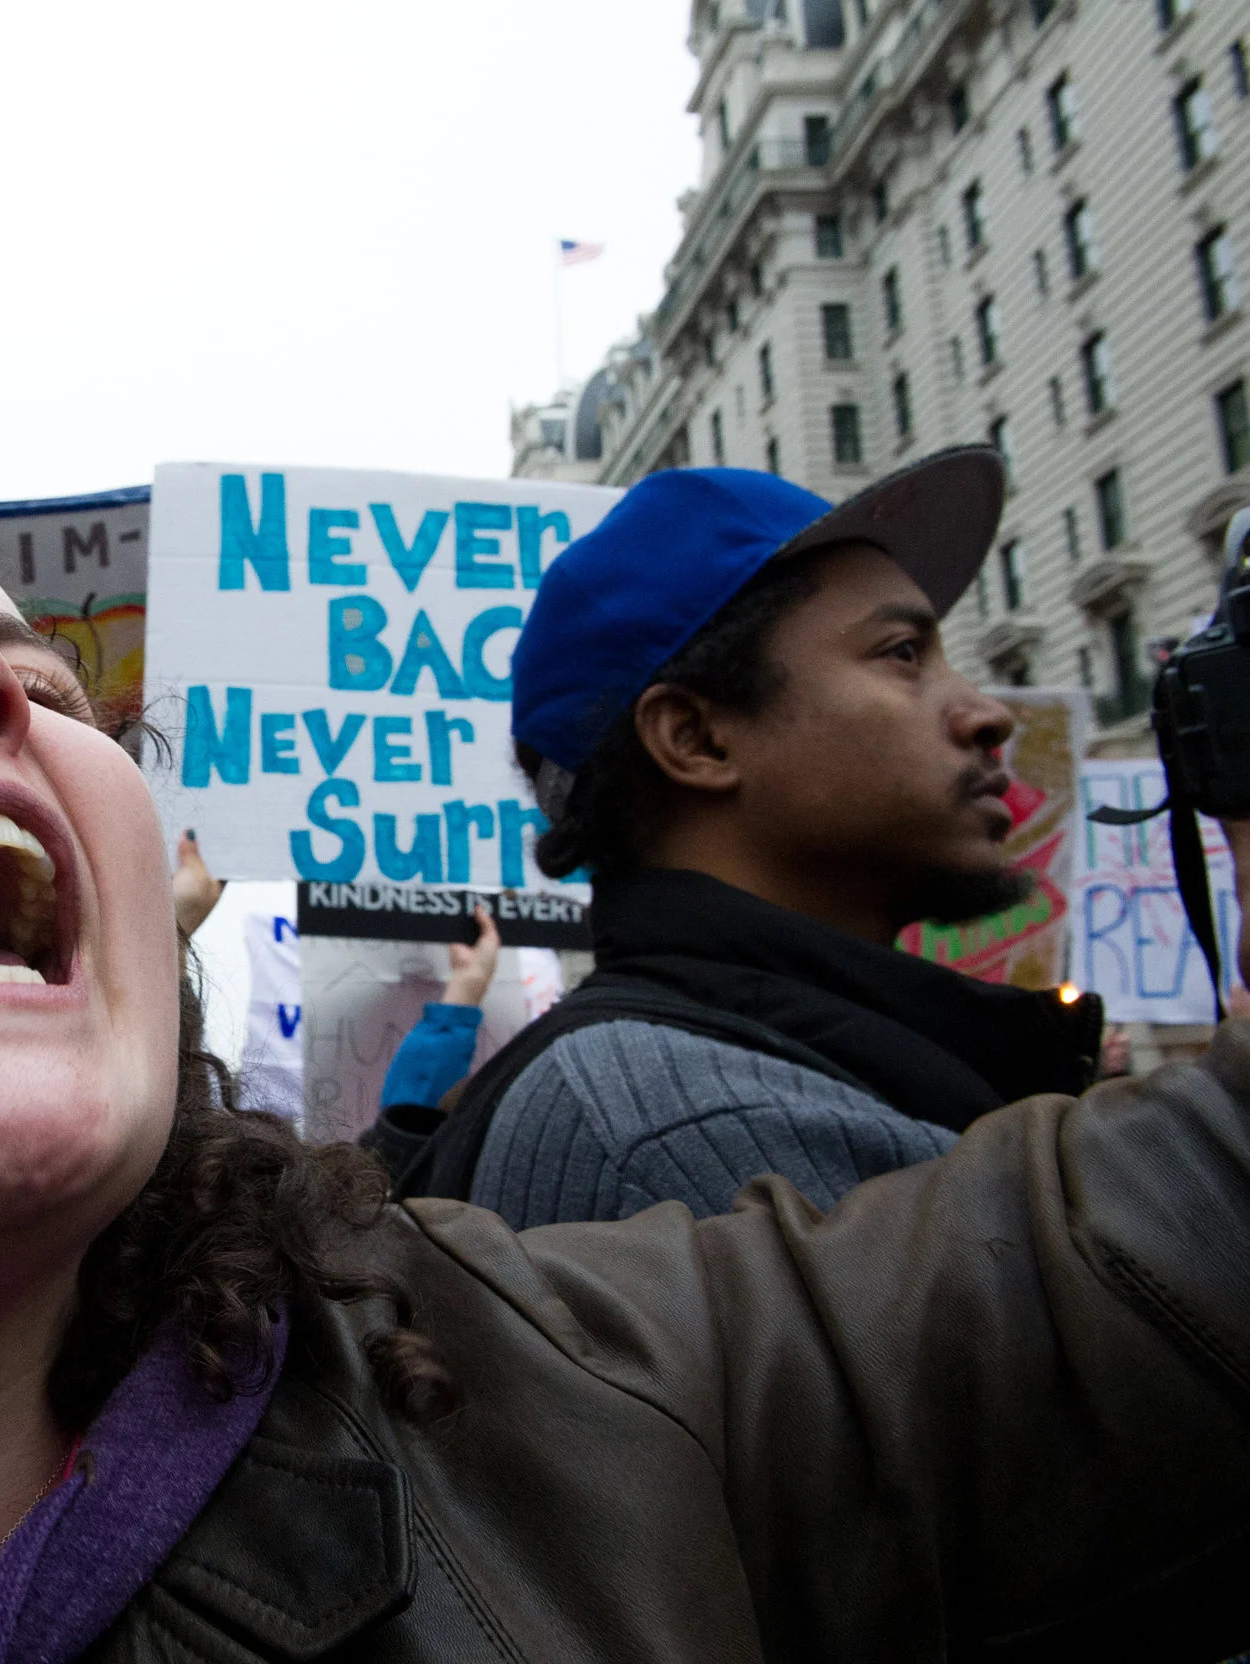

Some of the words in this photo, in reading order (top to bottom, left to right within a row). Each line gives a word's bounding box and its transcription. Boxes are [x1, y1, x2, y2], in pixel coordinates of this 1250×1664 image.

[327, 594, 526, 702] BAC
[289, 776, 588, 889] Surr
[308, 882, 461, 917] KINDNESS
